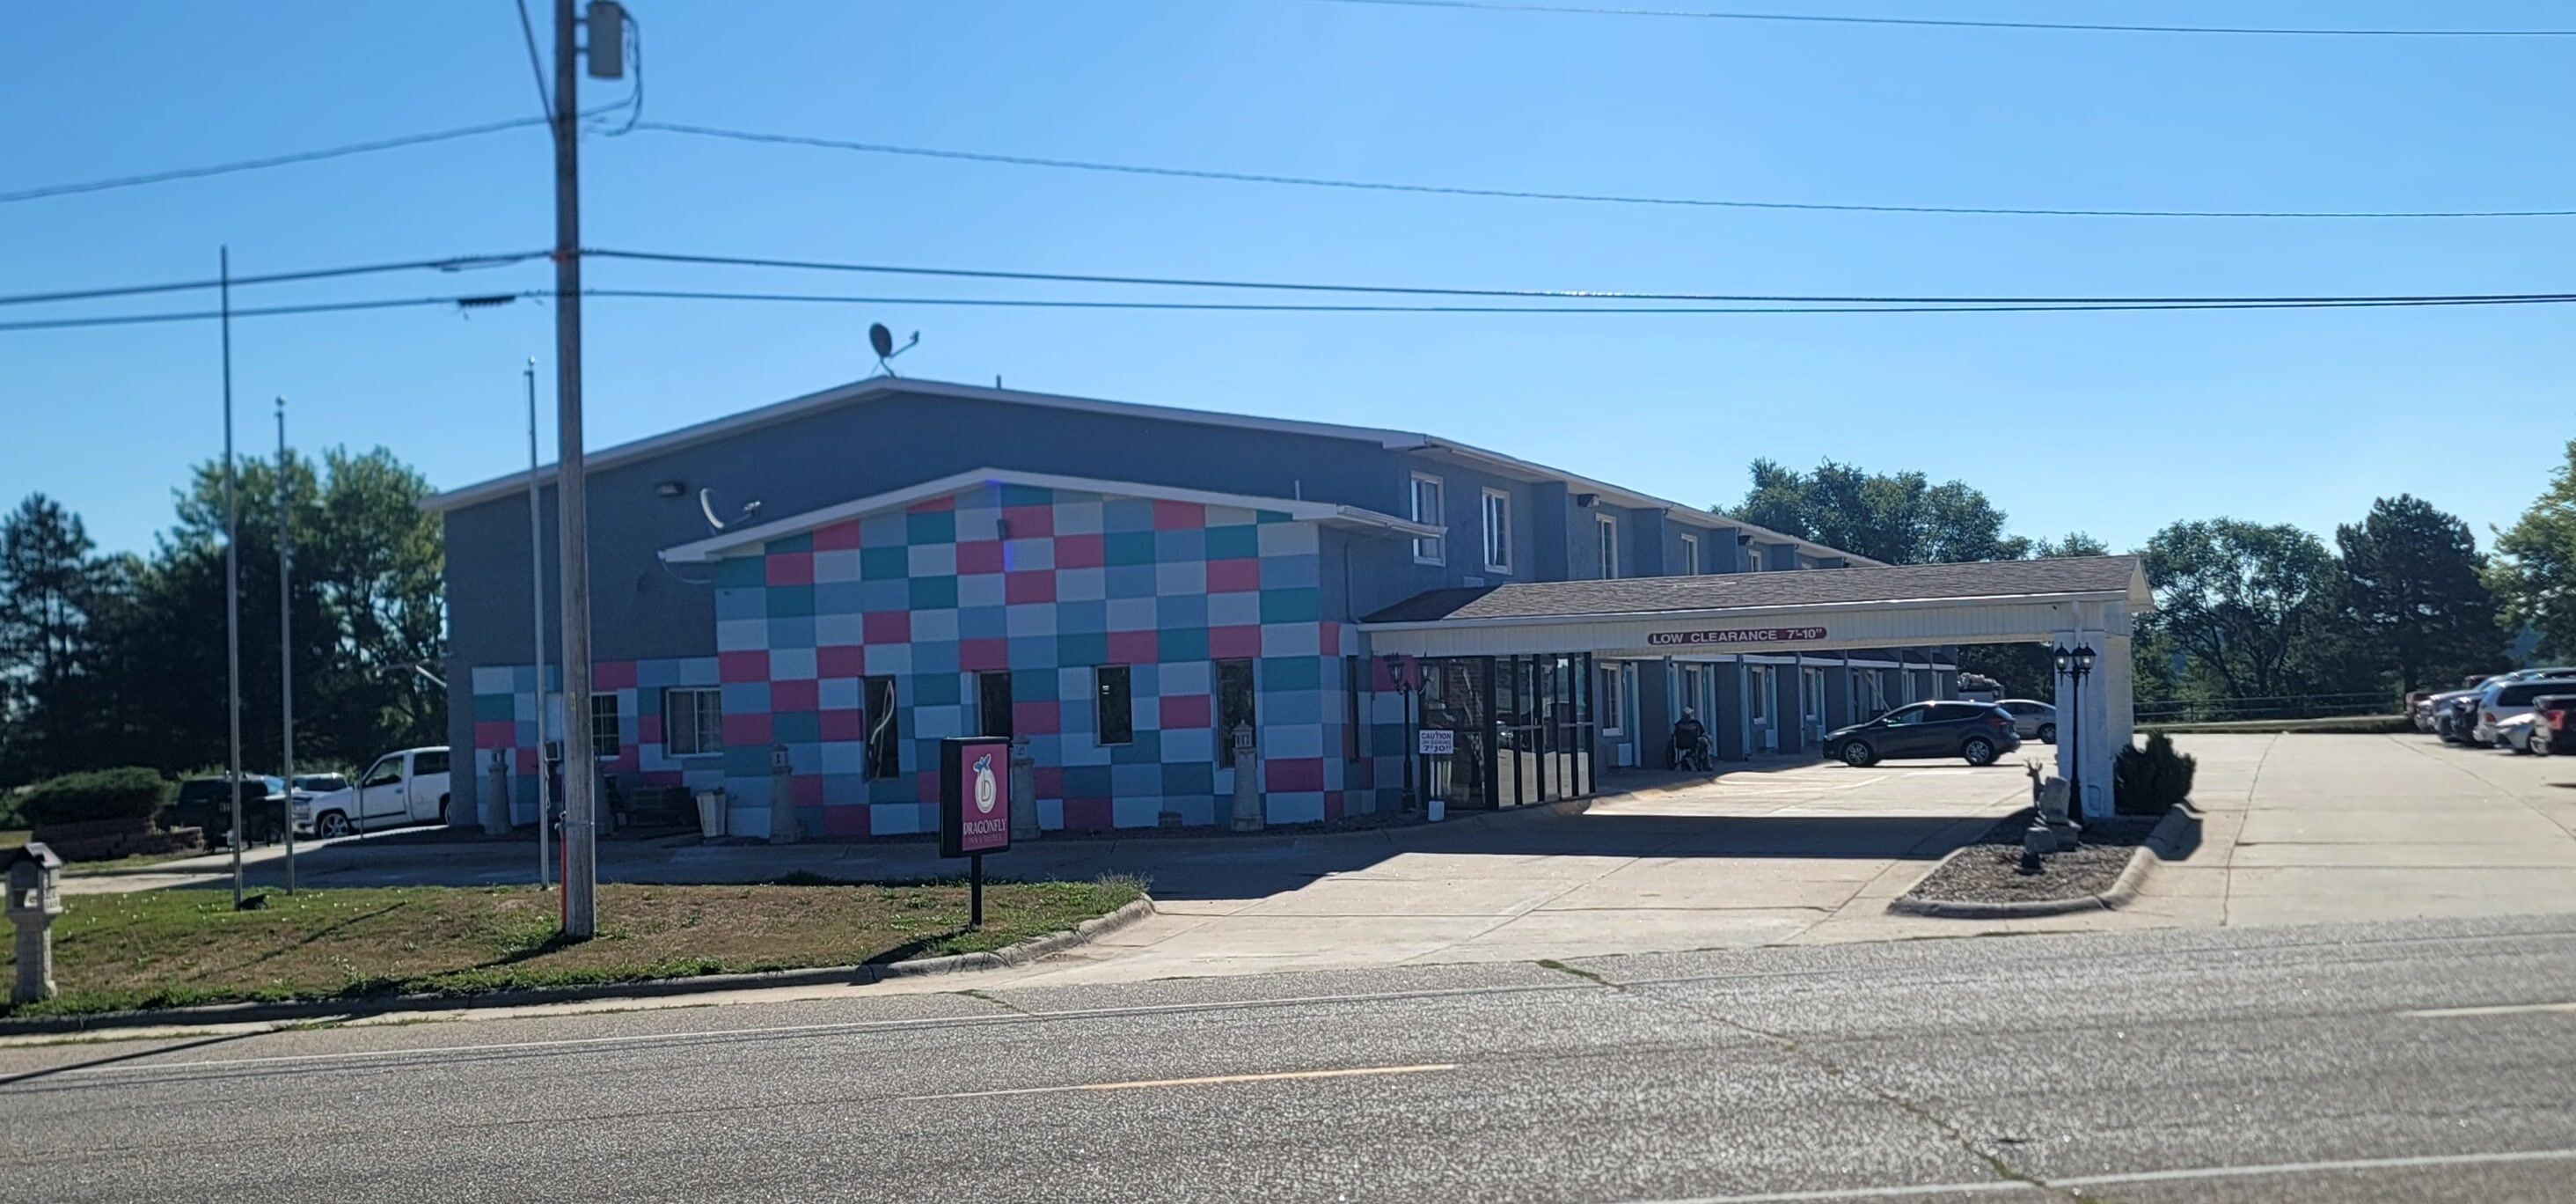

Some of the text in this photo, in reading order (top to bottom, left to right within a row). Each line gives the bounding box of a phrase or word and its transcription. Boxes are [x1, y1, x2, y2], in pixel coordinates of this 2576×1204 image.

[1653, 634, 1684, 644] LOW
[1690, 629, 1777, 643] CLEARANCE
[962, 819, 1006, 836] DRAGONFLY
